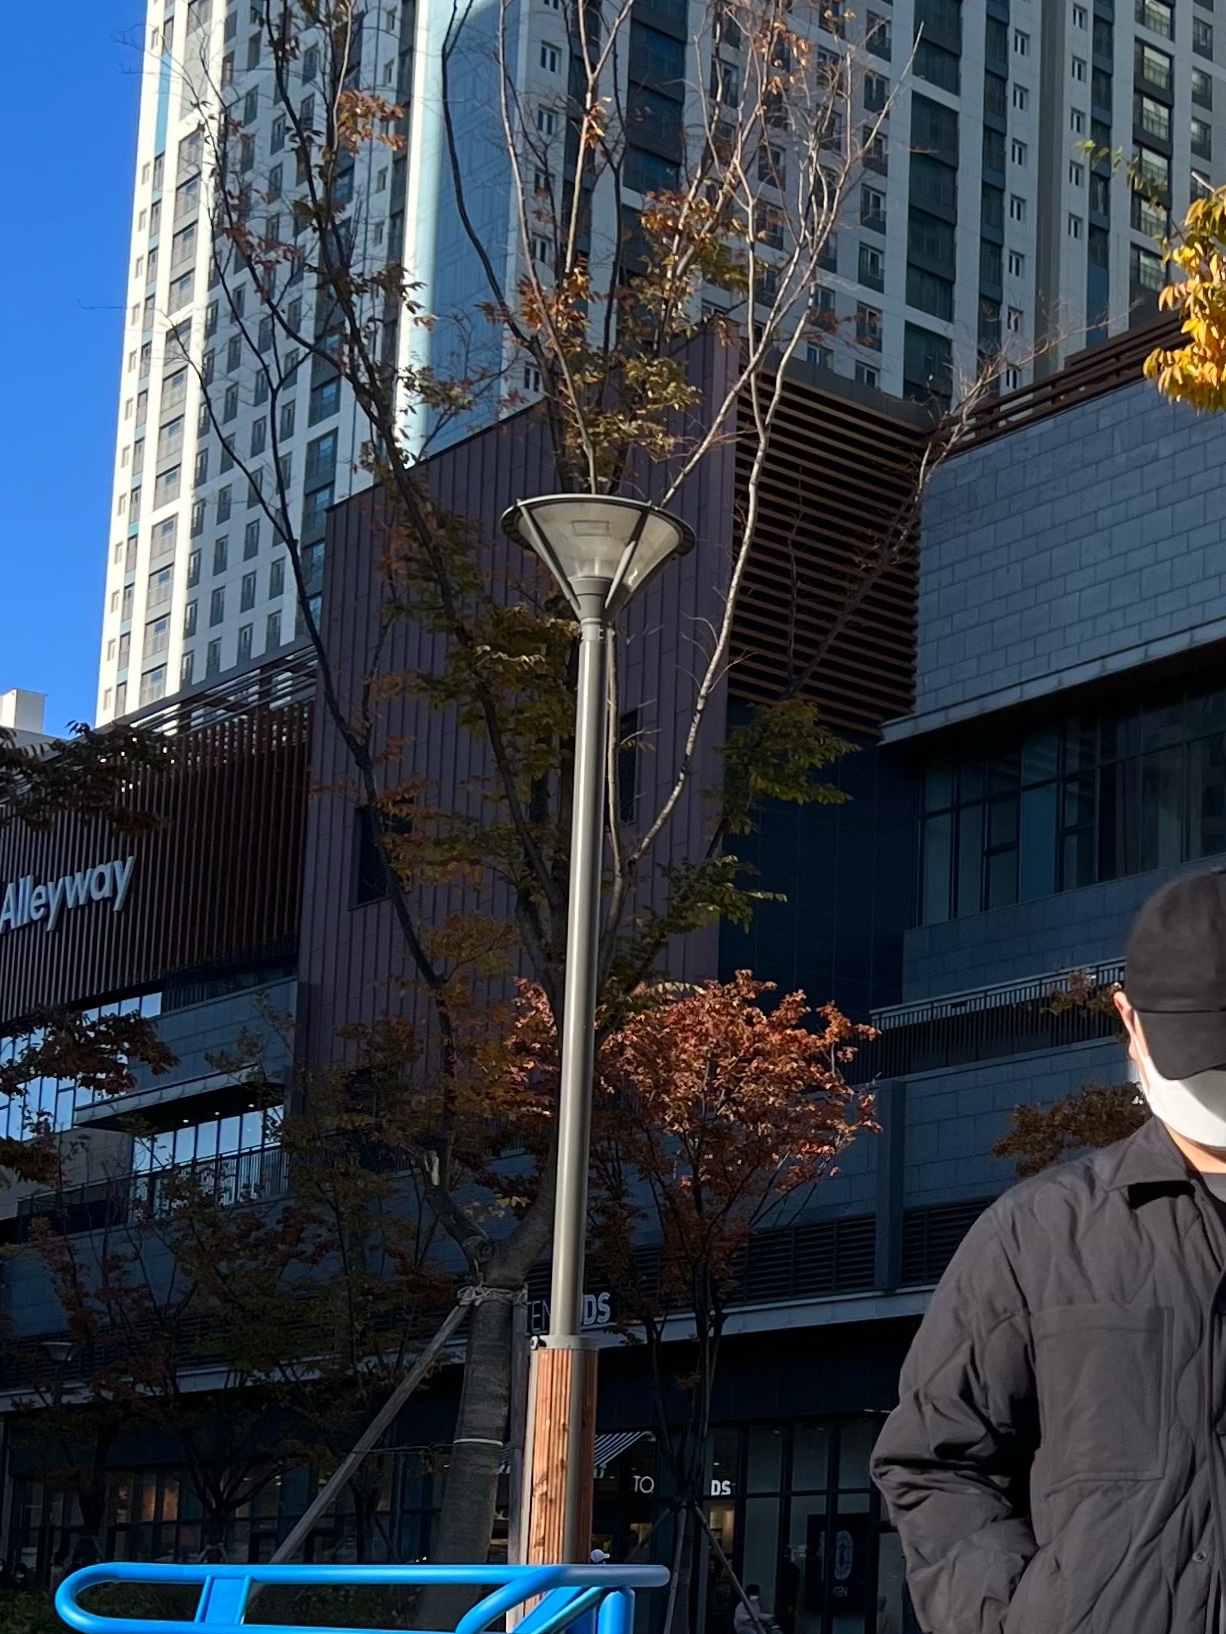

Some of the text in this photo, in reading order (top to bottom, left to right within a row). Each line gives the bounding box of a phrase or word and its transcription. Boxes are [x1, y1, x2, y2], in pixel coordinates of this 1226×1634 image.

[0, 855, 135, 934] Alleyway
[583, 1292, 611, 1326] DS
[711, 1479, 731, 1496] DS
